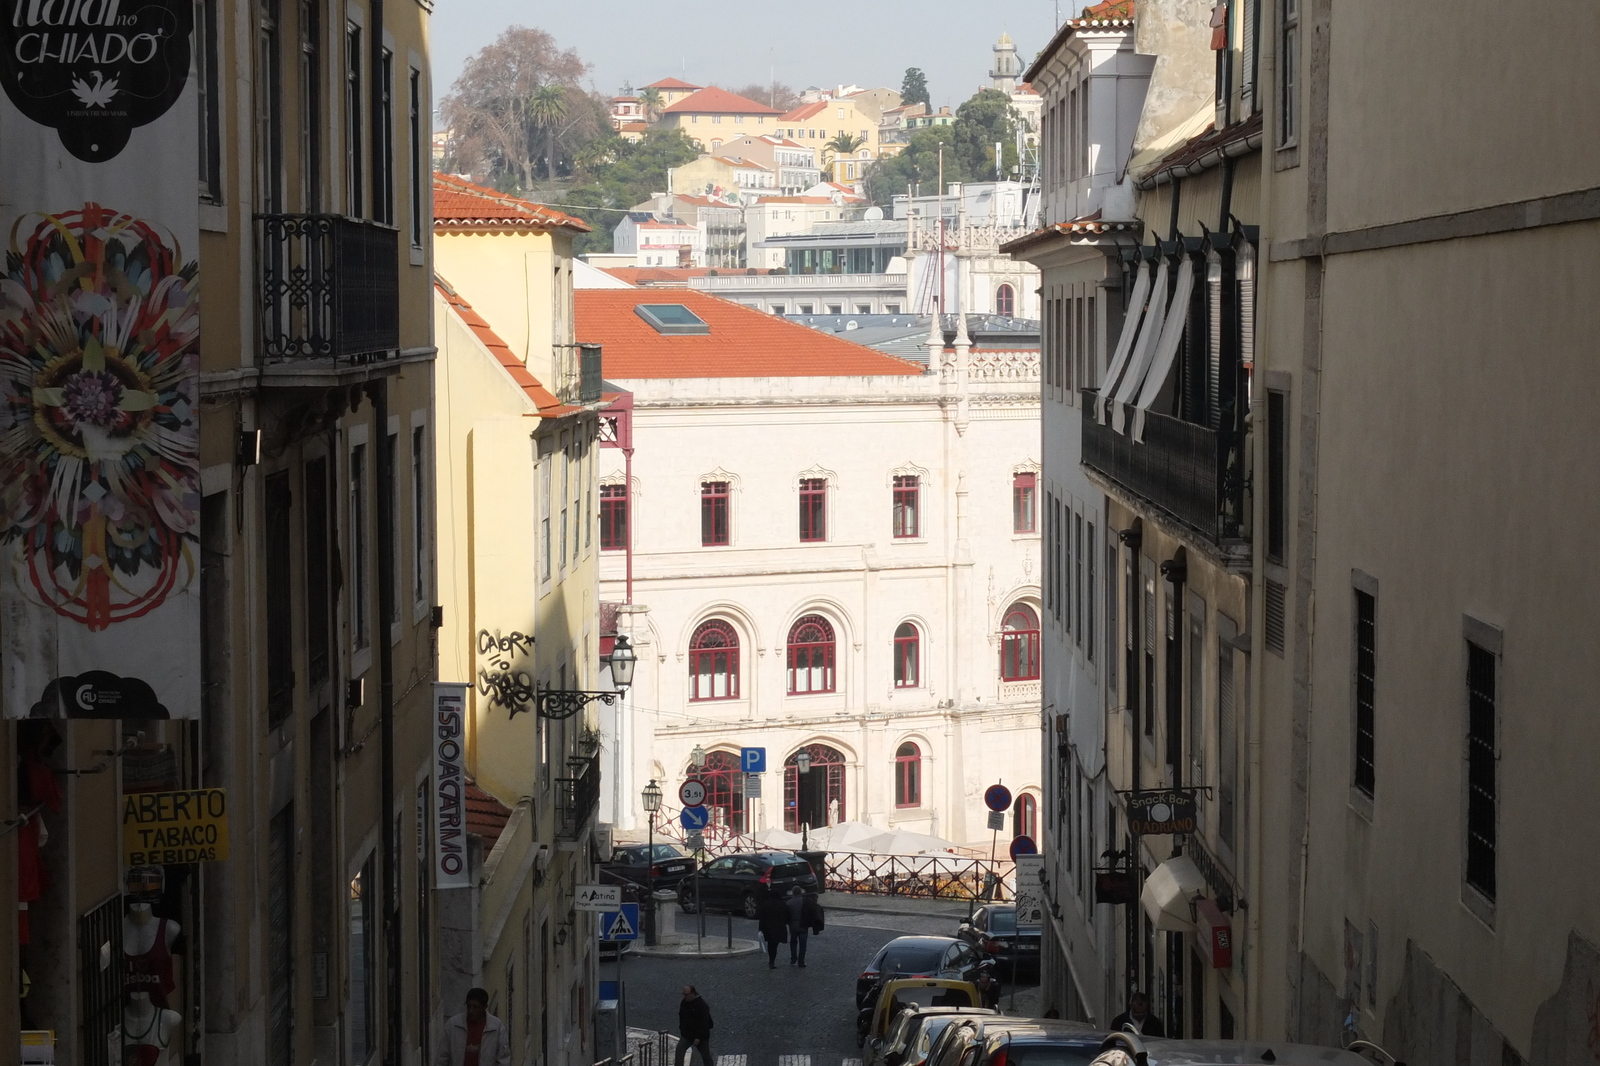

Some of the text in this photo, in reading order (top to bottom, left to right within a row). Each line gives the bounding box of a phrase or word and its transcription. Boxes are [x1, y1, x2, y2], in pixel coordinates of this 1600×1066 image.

[15, 32, 158, 65] CHIADO
[746, 750, 760, 770] P
[123, 789, 225, 825] ABERTO
[1132, 817, 1193, 834] O ADRIANO
[138, 824, 217, 848] TABACO
[130, 846, 216, 866] BEBIDAS
[581, 890, 588, 899] A
